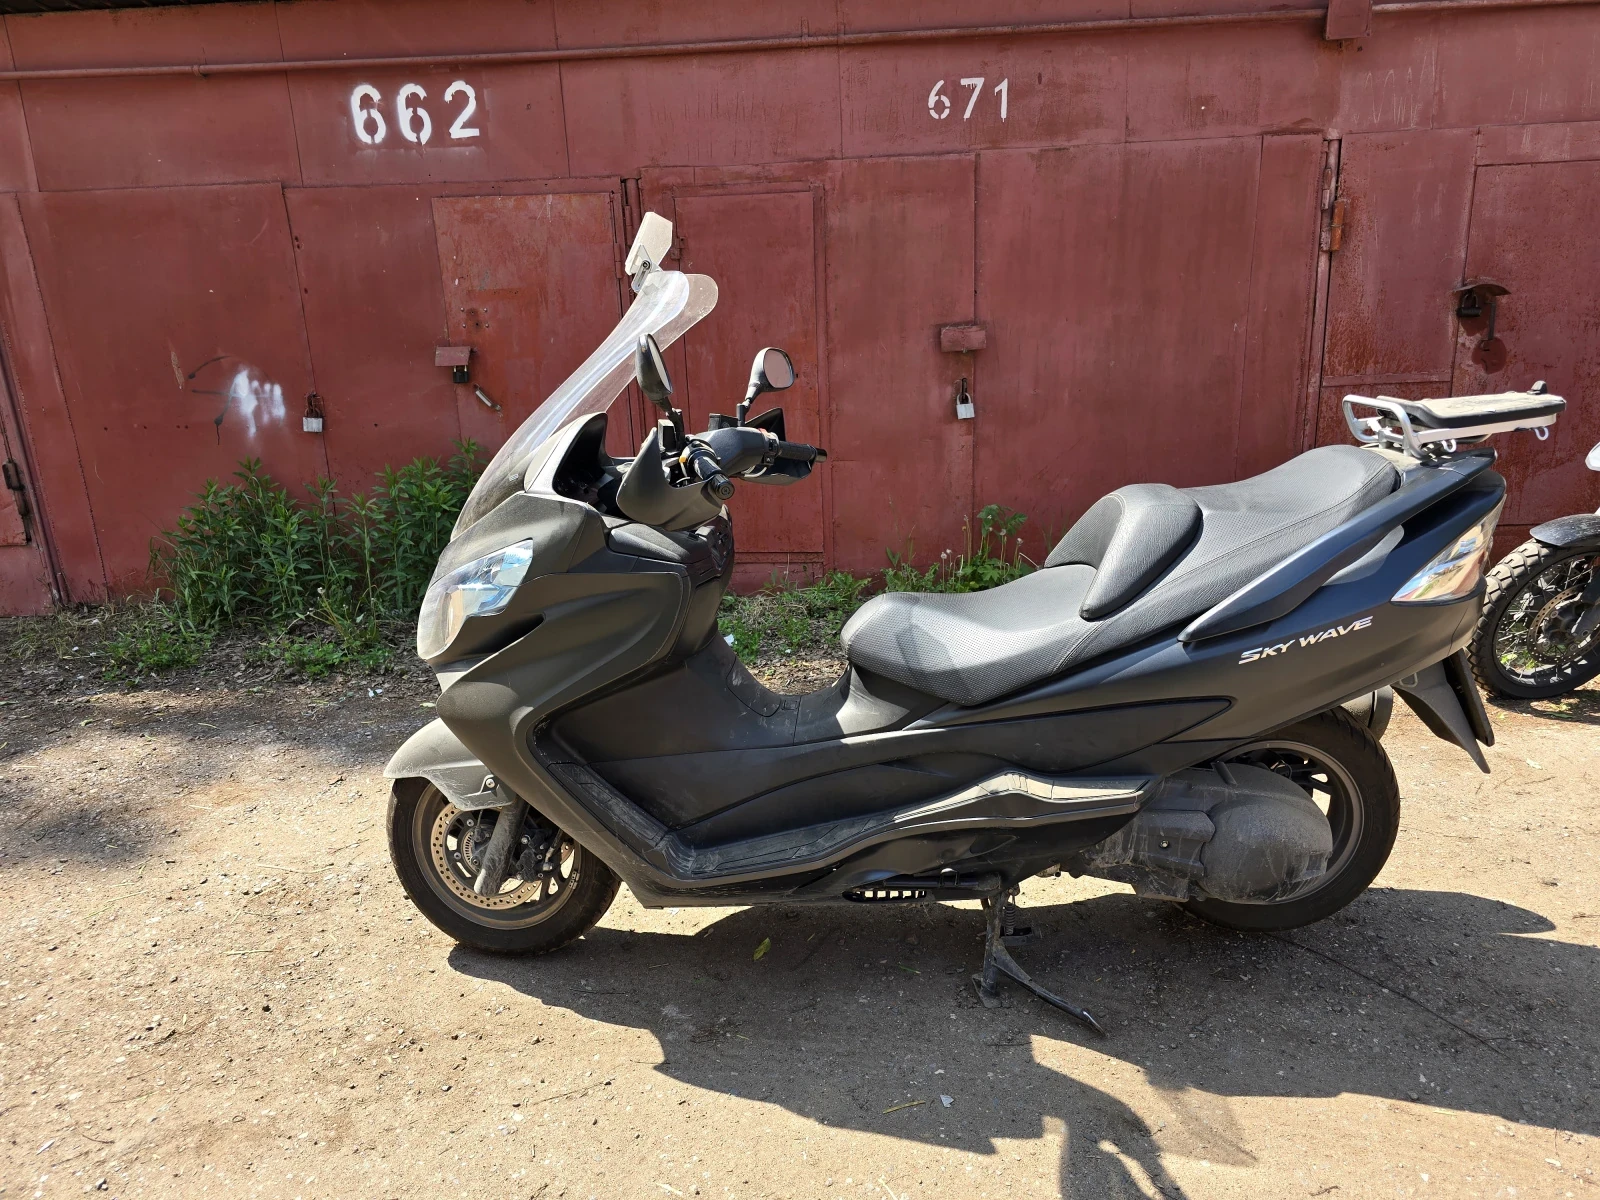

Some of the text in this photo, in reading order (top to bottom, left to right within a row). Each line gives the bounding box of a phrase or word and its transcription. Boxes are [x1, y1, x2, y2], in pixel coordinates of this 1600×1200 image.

[351, 80, 480, 145] 662
[928, 77, 1008, 121] 671
[1238, 615, 1374, 665] SKY WAVE
